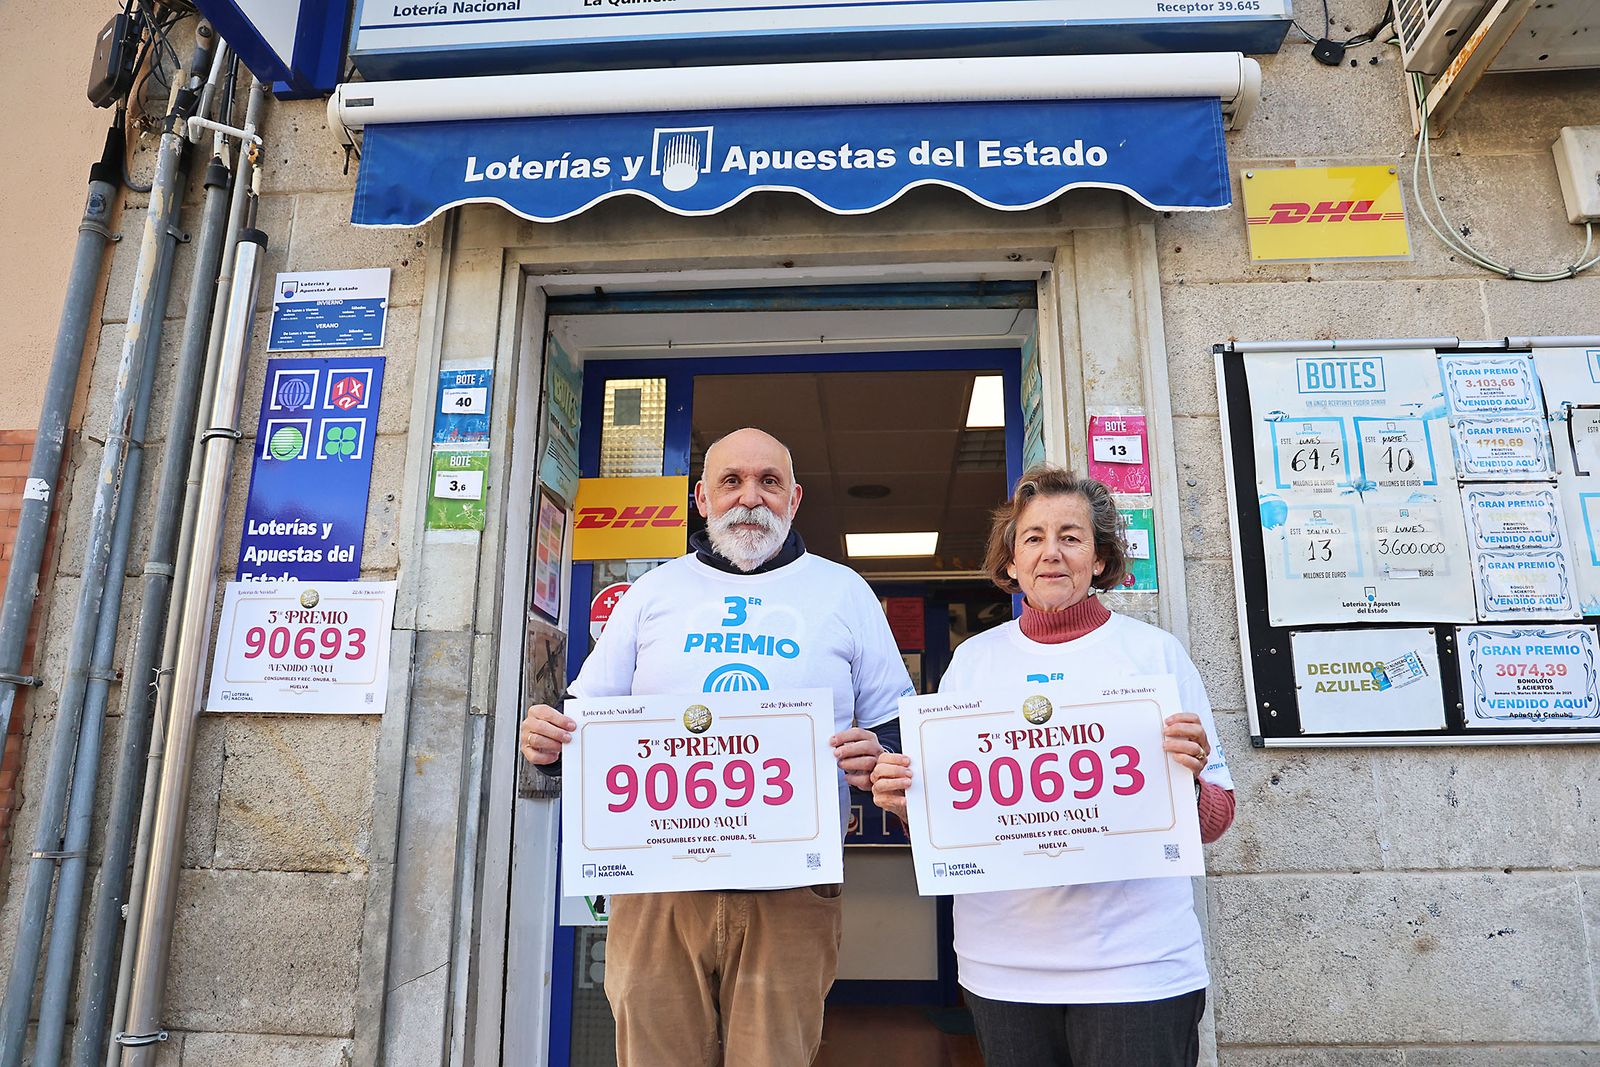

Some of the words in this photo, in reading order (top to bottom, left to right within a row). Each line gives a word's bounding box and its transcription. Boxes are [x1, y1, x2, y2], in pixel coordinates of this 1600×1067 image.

[393, 1, 447, 17] Lotería
[452, 0, 521, 14] Nacional
[1157, 3, 1214, 14] Receptor
[1218, 1, 1260, 11] 39.645
[464, 151, 611, 184] Loterías
[620, 157, 643, 182] y
[721, 143, 897, 175] Apuestas
[908, 140, 965, 169] del
[978, 140, 1108, 168] Estado
[1268, 200, 1383, 225] DHL
[1305, 361, 1376, 390] BOTES
[1483, 367, 1519, 375] PREMIO
[456, 374, 476, 385] BOTE
[455, 397, 472, 407] 40
[1461, 399, 1503, 407] VENDIDO
[1105, 420, 1127, 432] BOTE
[1495, 426, 1532, 434] PREMIO
[1109, 445, 1127, 456] 13
[450, 456, 471, 466] BOTE
[1473, 459, 1514, 468] VENDIDO
[449, 480, 466, 492] 3,6
[575, 506, 686, 529] DHL
[248, 518, 318, 536] Loterías
[321, 521, 333, 540] y
[1483, 535, 1526, 543] VENDIDO
[243, 545, 323, 564] Apuestas
[327, 545, 355, 563] del
[1308, 538, 1333, 562] 13
[1517, 561, 1556, 569] PREMIO
[1493, 597, 1536, 606] VENDIDO
[285, 610, 349, 625] PREMIO
[243, 626, 367, 661] 90693
[684, 632, 800, 659] PREMIO
[1481, 646, 1521, 656] GRAN
[1526, 645, 1580, 656] PREMIO
[268, 664, 308, 673] VENDIDO
[1307, 660, 1386, 676] DECIMOS
[1495, 663, 1568, 679] 3074,39
[1314, 678, 1382, 693] AZULES
[1102, 688, 1111, 696] 22
[1111, 688, 1120, 696] de
[769, 701, 778, 709] de
[778, 700, 813, 709] Diciembre
[1487, 698, 1549, 709] VENDIDO
[1004, 722, 1105, 751] PREMIO
[663, 734, 759, 759] PREMIO
[947, 744, 1146, 811] 90693
[605, 757, 794, 813] 90693
[650, 816, 710, 831] VENDIDO
[713, 812, 748, 829] AQUÍ
[997, 810, 1060, 828] VENDIDO
[1063, 804, 1099, 822] AQUÍ
[646, 836, 696, 845] CONSUMIBLES
[719, 834, 748, 842] ONUBA,
[995, 831, 1048, 842] CONSUMIBLES
[1053, 829, 1070, 838] REC.
[1070, 826, 1101, 836] ONUBA,
[1101, 825, 1110, 833] SL
[687, 847, 716, 855] HUELVA
[1038, 841, 1068, 850] HUELVA
[598, 862, 627, 872] LOTERÍA
[948, 861, 978, 871] LOTERÍA
[598, 870, 634, 878] NACIONAL
[949, 867, 985, 878] NACIONAL
